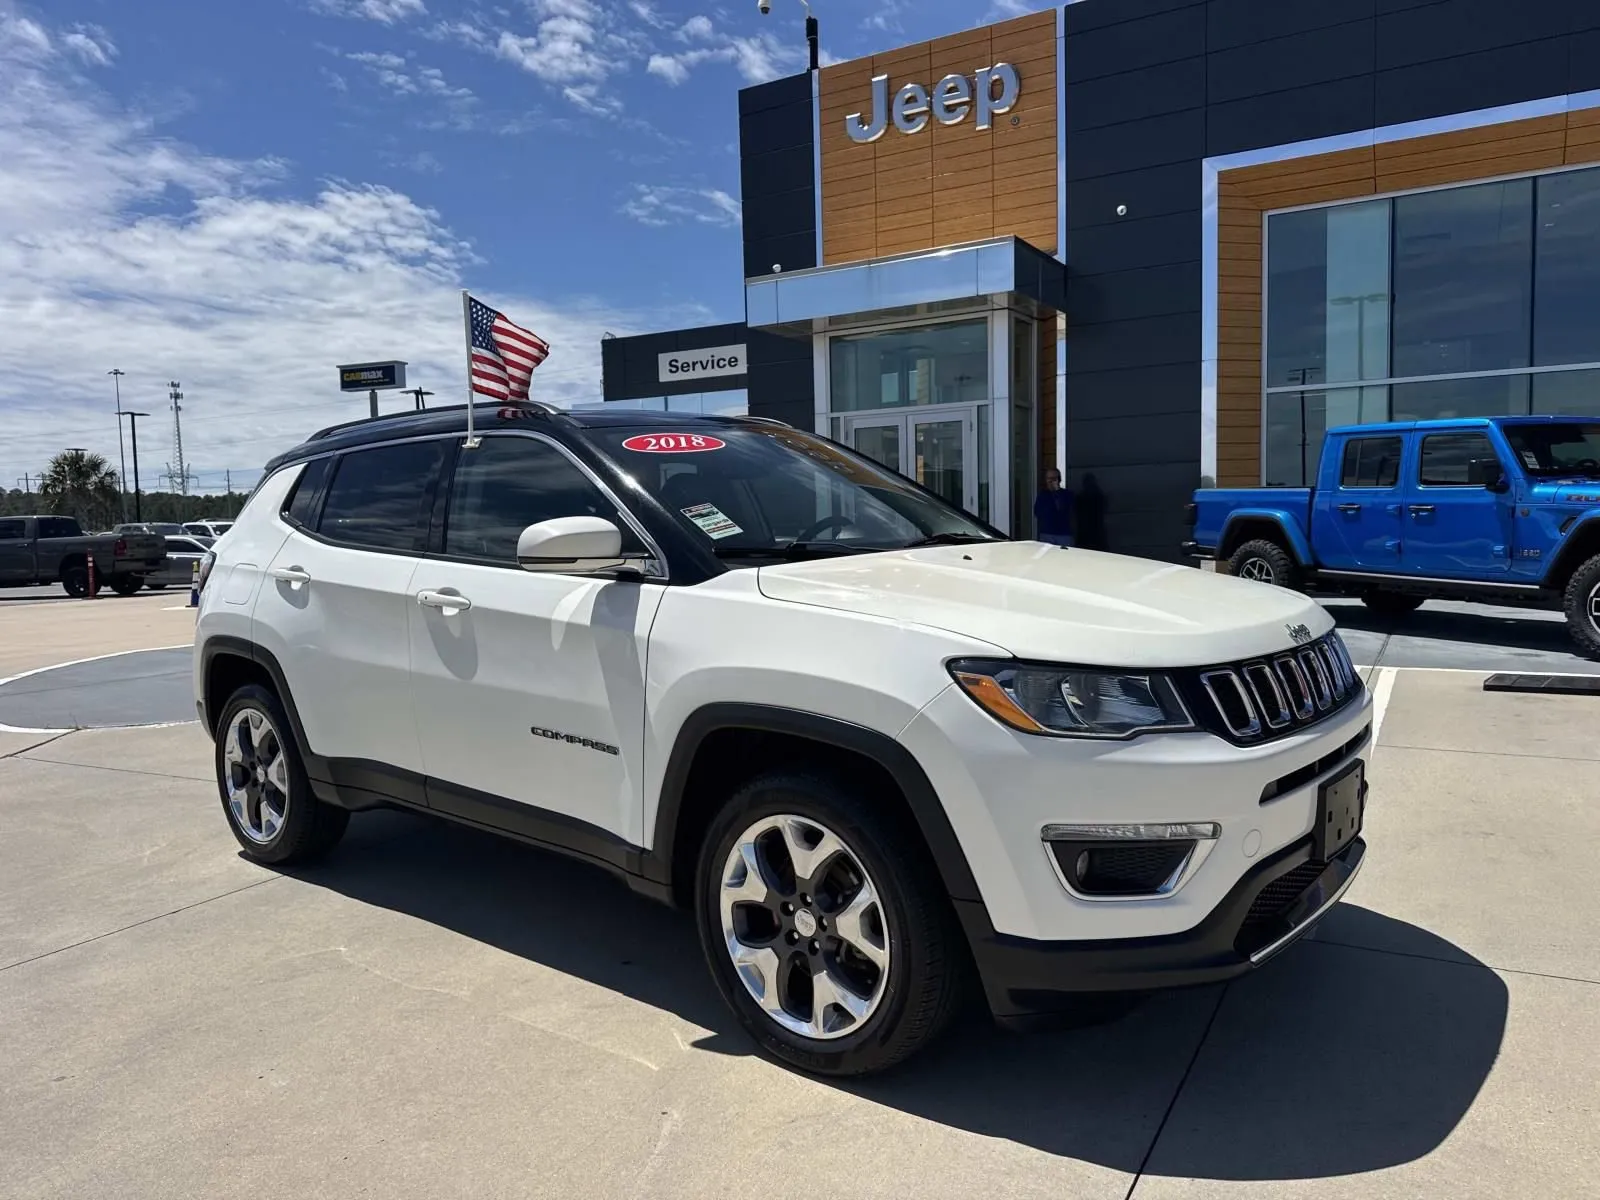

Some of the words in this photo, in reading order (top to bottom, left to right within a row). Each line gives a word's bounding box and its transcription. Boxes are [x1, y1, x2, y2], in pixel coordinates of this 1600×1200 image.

[845, 62, 1021, 143] Jeep
[668, 355, 739, 374] Service
[643, 435, 706, 451] 2018
[530, 726, 620, 755] COMPASS
